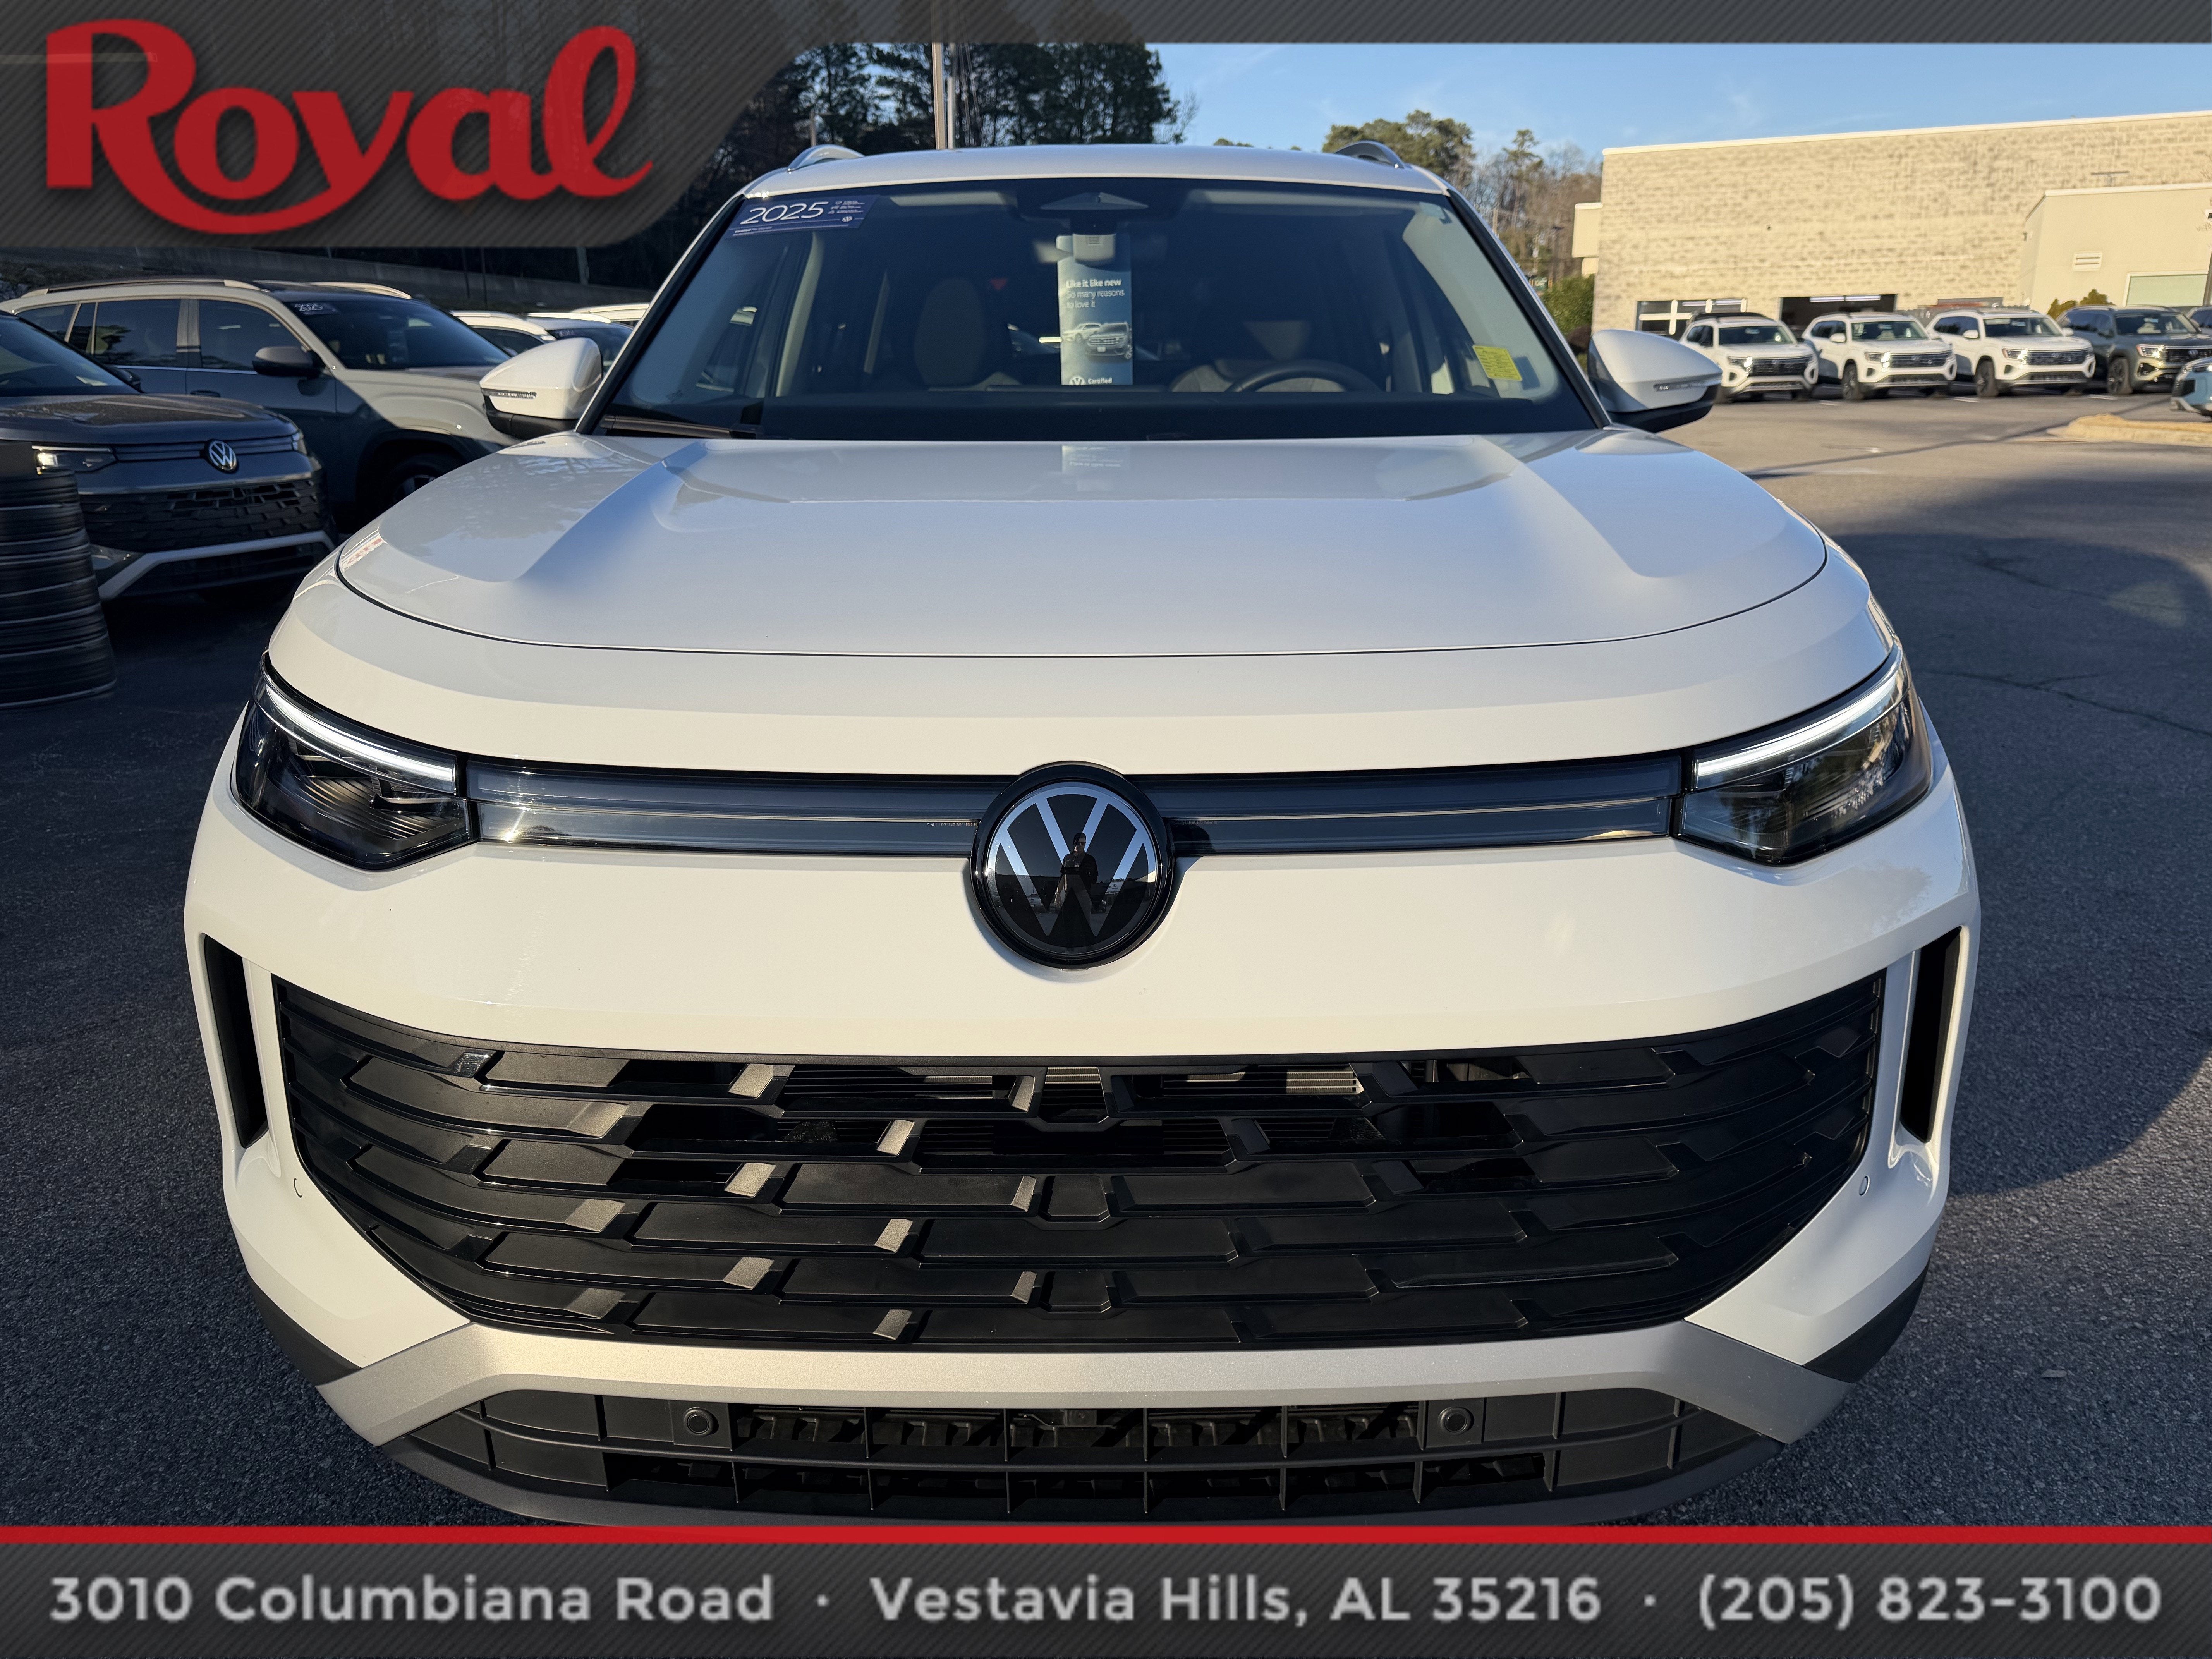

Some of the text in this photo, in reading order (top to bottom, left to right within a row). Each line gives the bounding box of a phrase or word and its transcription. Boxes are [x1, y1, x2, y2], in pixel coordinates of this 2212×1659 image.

[740, 201, 829, 225] 2025
[1065, 280, 1082, 288] Like
[1089, 279, 1103, 287] like
[1077, 291, 1097, 299] many
[295, 303, 323, 311] 2025
